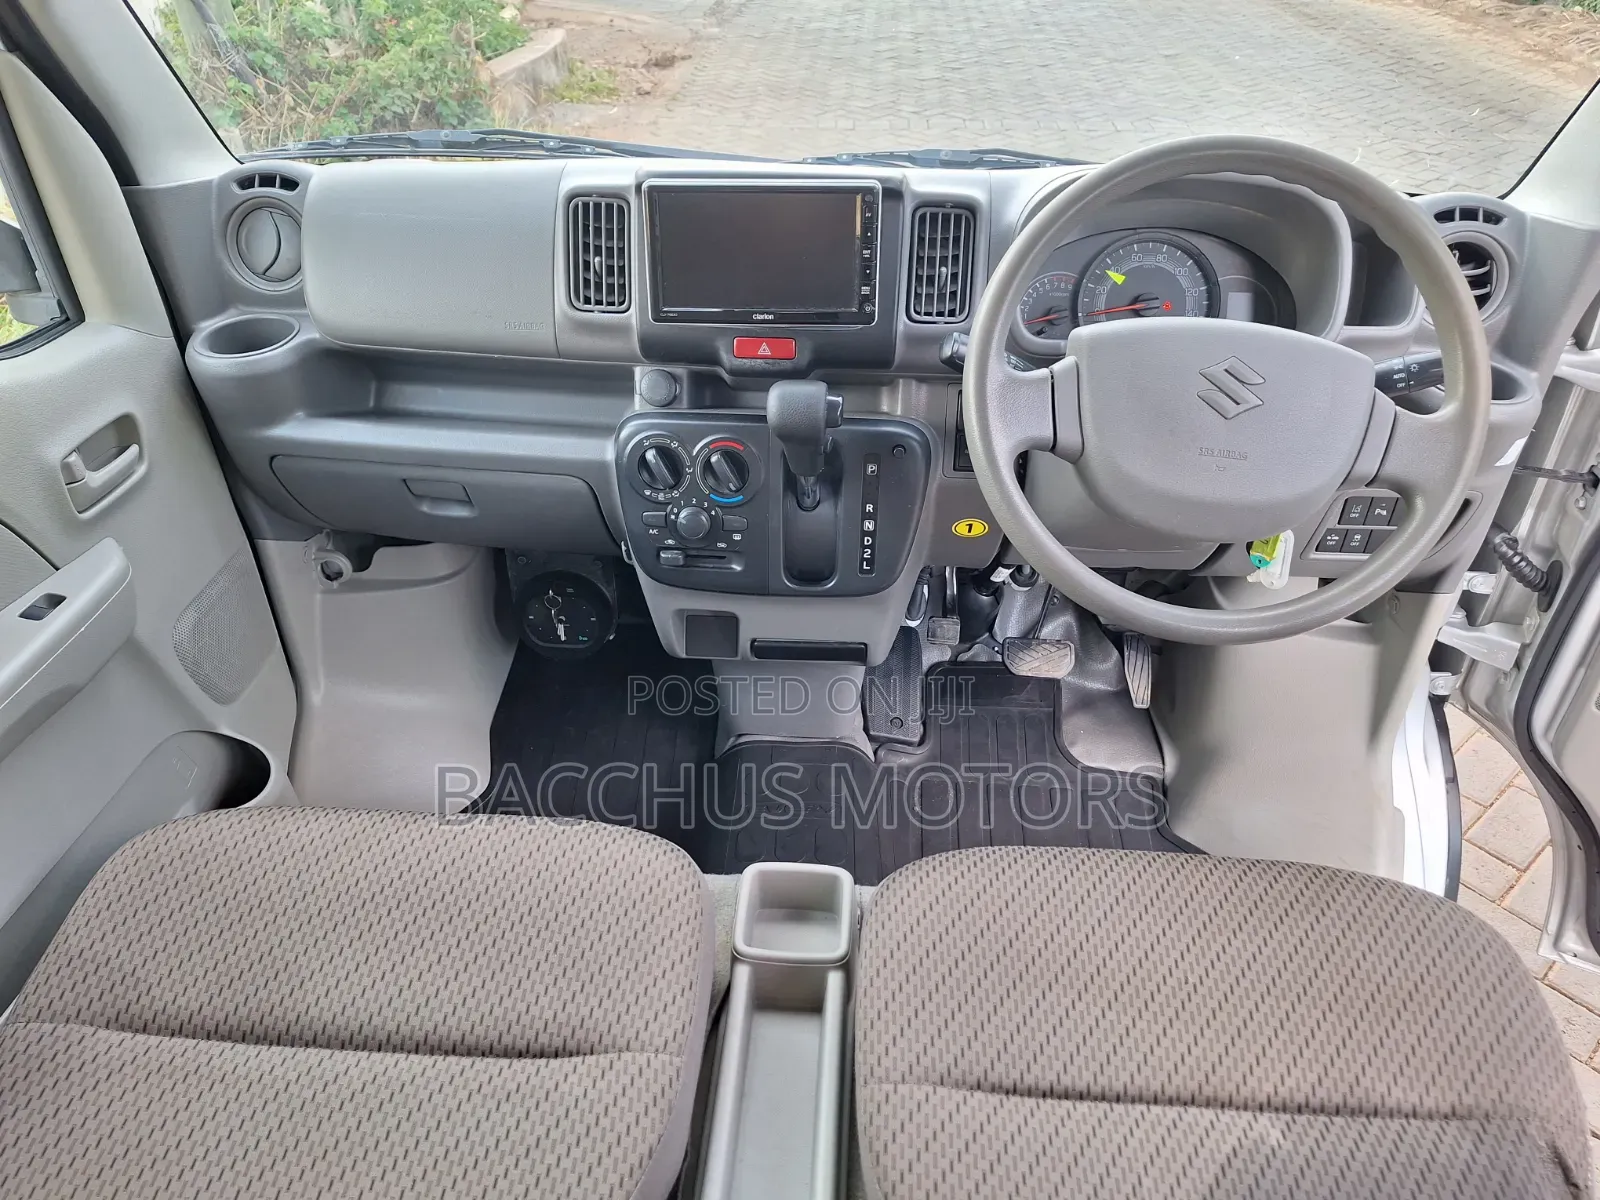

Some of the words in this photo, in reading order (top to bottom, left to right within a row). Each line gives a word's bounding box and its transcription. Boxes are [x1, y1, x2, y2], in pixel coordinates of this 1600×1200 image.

[1131, 253, 1143, 262] 60
[1156, 253, 1168, 262] 80
[1174, 267, 1189, 276] 100
[1095, 285, 1107, 294] 20
[1184, 288, 1199, 296] 120
[1199, 446, 1215, 455] SRS
[1216, 449, 1249, 460] AIRBAG
[868, 465, 876, 474] P
[866, 504, 874, 513] R
[865, 521, 873, 530] N
[965, 523, 973, 534] 1
[864, 536, 872, 545] D
[863, 549, 871, 558] 2
[863, 561, 871, 570] L
